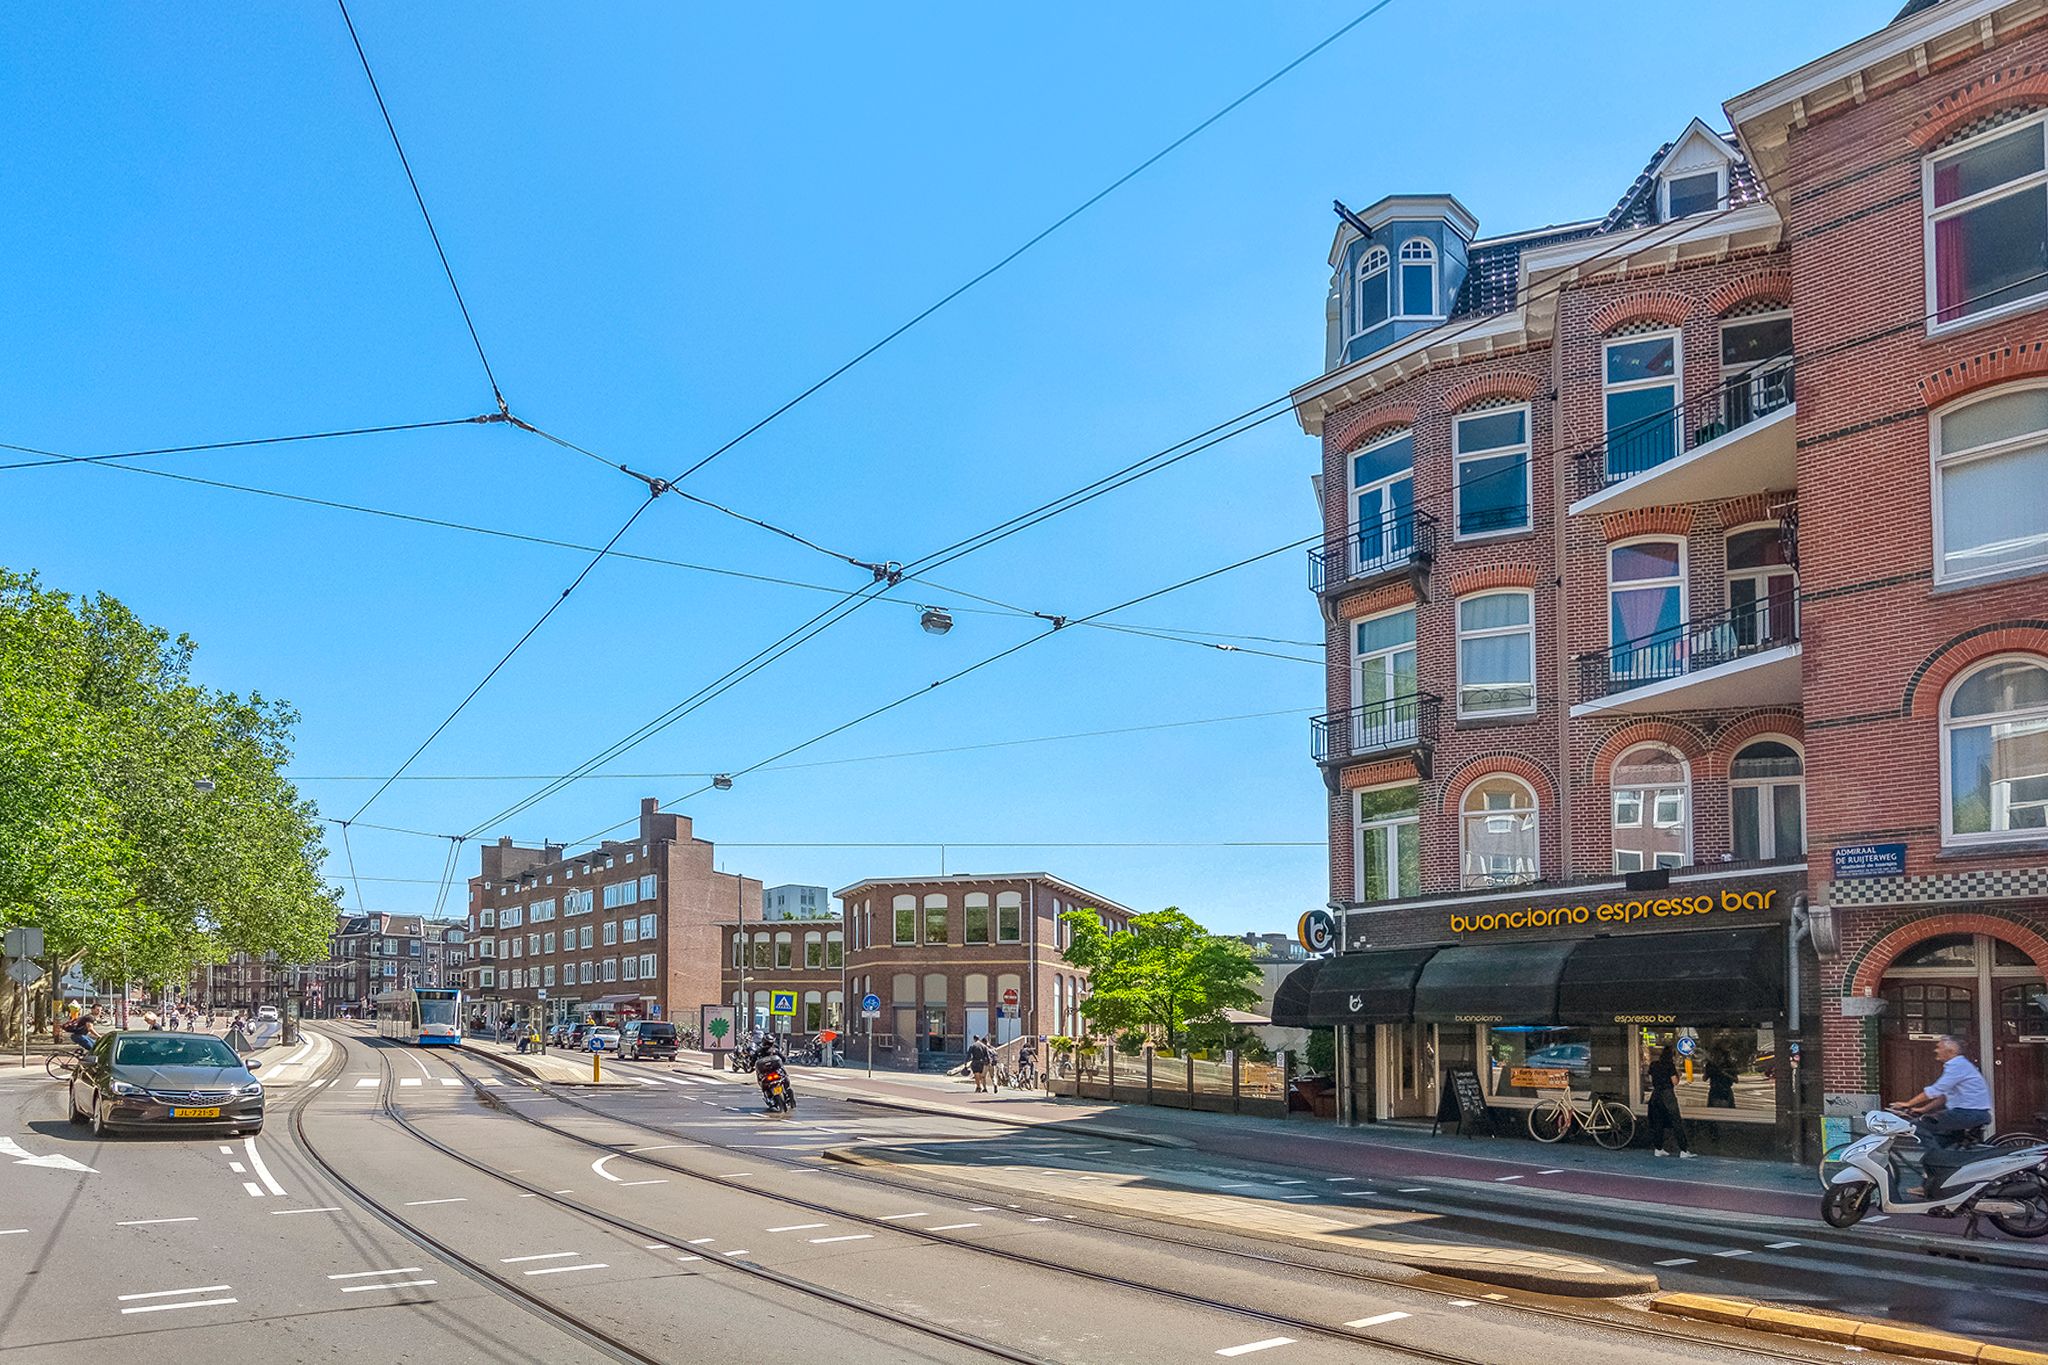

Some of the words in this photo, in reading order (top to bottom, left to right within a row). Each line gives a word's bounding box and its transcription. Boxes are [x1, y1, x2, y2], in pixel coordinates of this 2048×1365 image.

[1836, 847, 1876, 856] ADMIRAAL
[1836, 856, 1846, 864] DE
[1848, 853, 1897, 863] RUIJTERWEG
[1596, 895, 1714, 923] espresso
[1721, 890, 1777, 912] bar
[1614, 1015, 1656, 1024] espresso
[1657, 1014, 1676, 1023] bar
